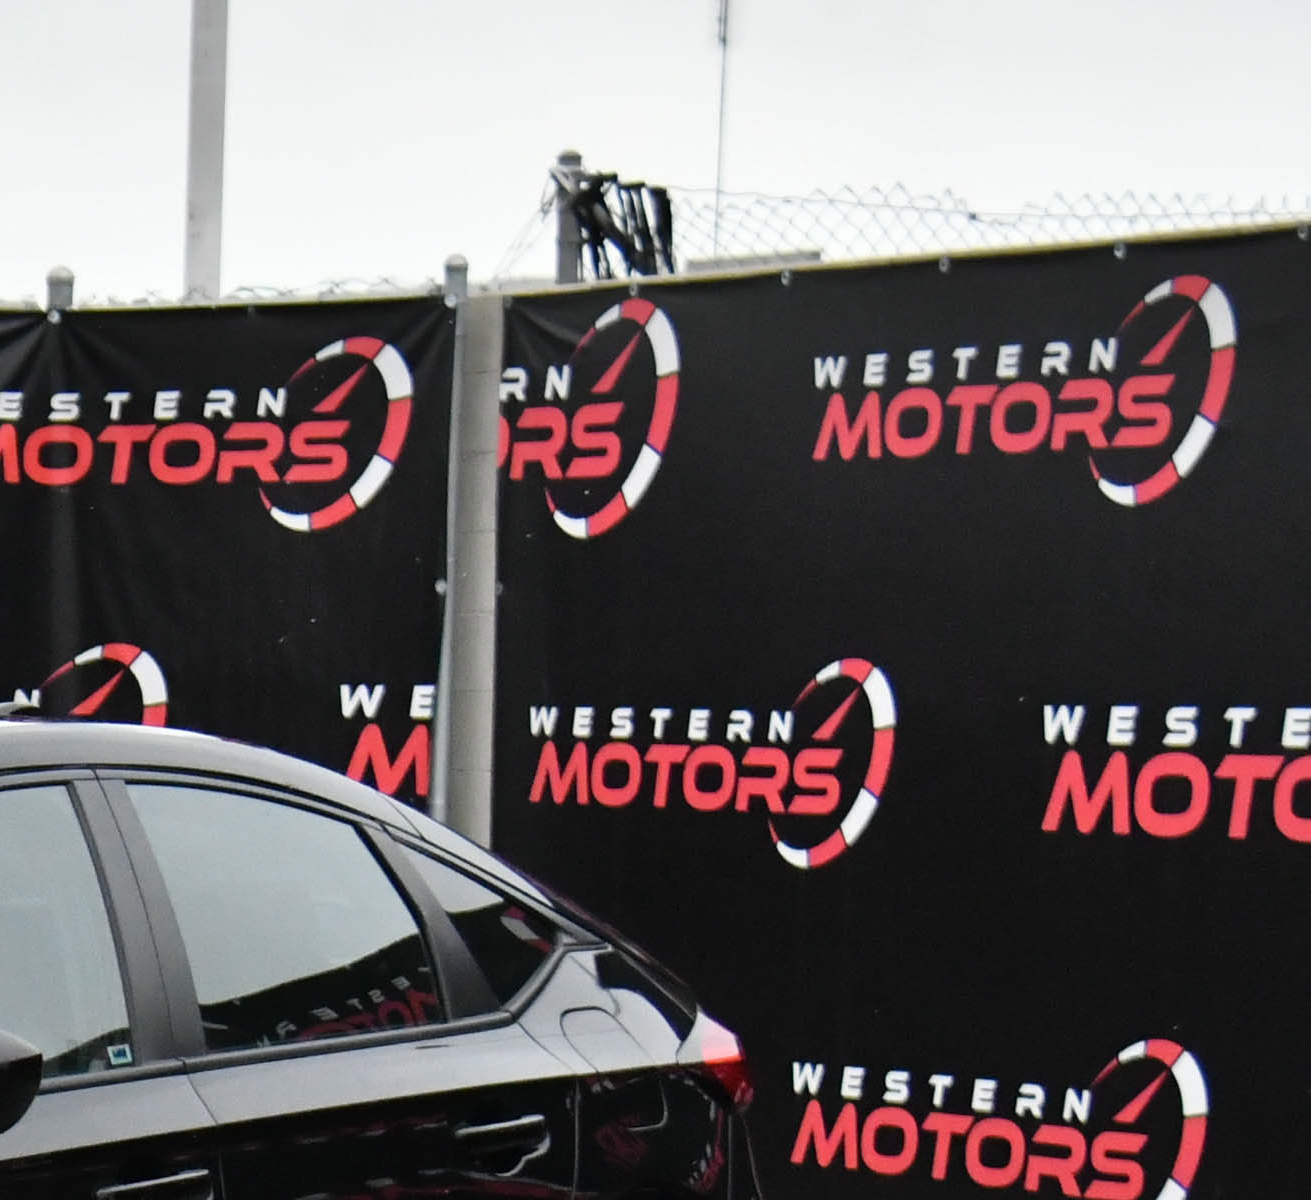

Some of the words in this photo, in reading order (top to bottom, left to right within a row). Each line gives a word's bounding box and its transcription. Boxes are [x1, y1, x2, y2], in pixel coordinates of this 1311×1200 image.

[815, 337, 1117, 389] WESTERN
[496, 402, 624, 481] RS
[813, 374, 1175, 461] MOTORS
[530, 706, 793, 743] WESTERN
[1043, 704, 1311, 749] WESTE
[529, 740, 844, 815] MOTORS
[792, 1061, 1091, 1123] WESTERN
